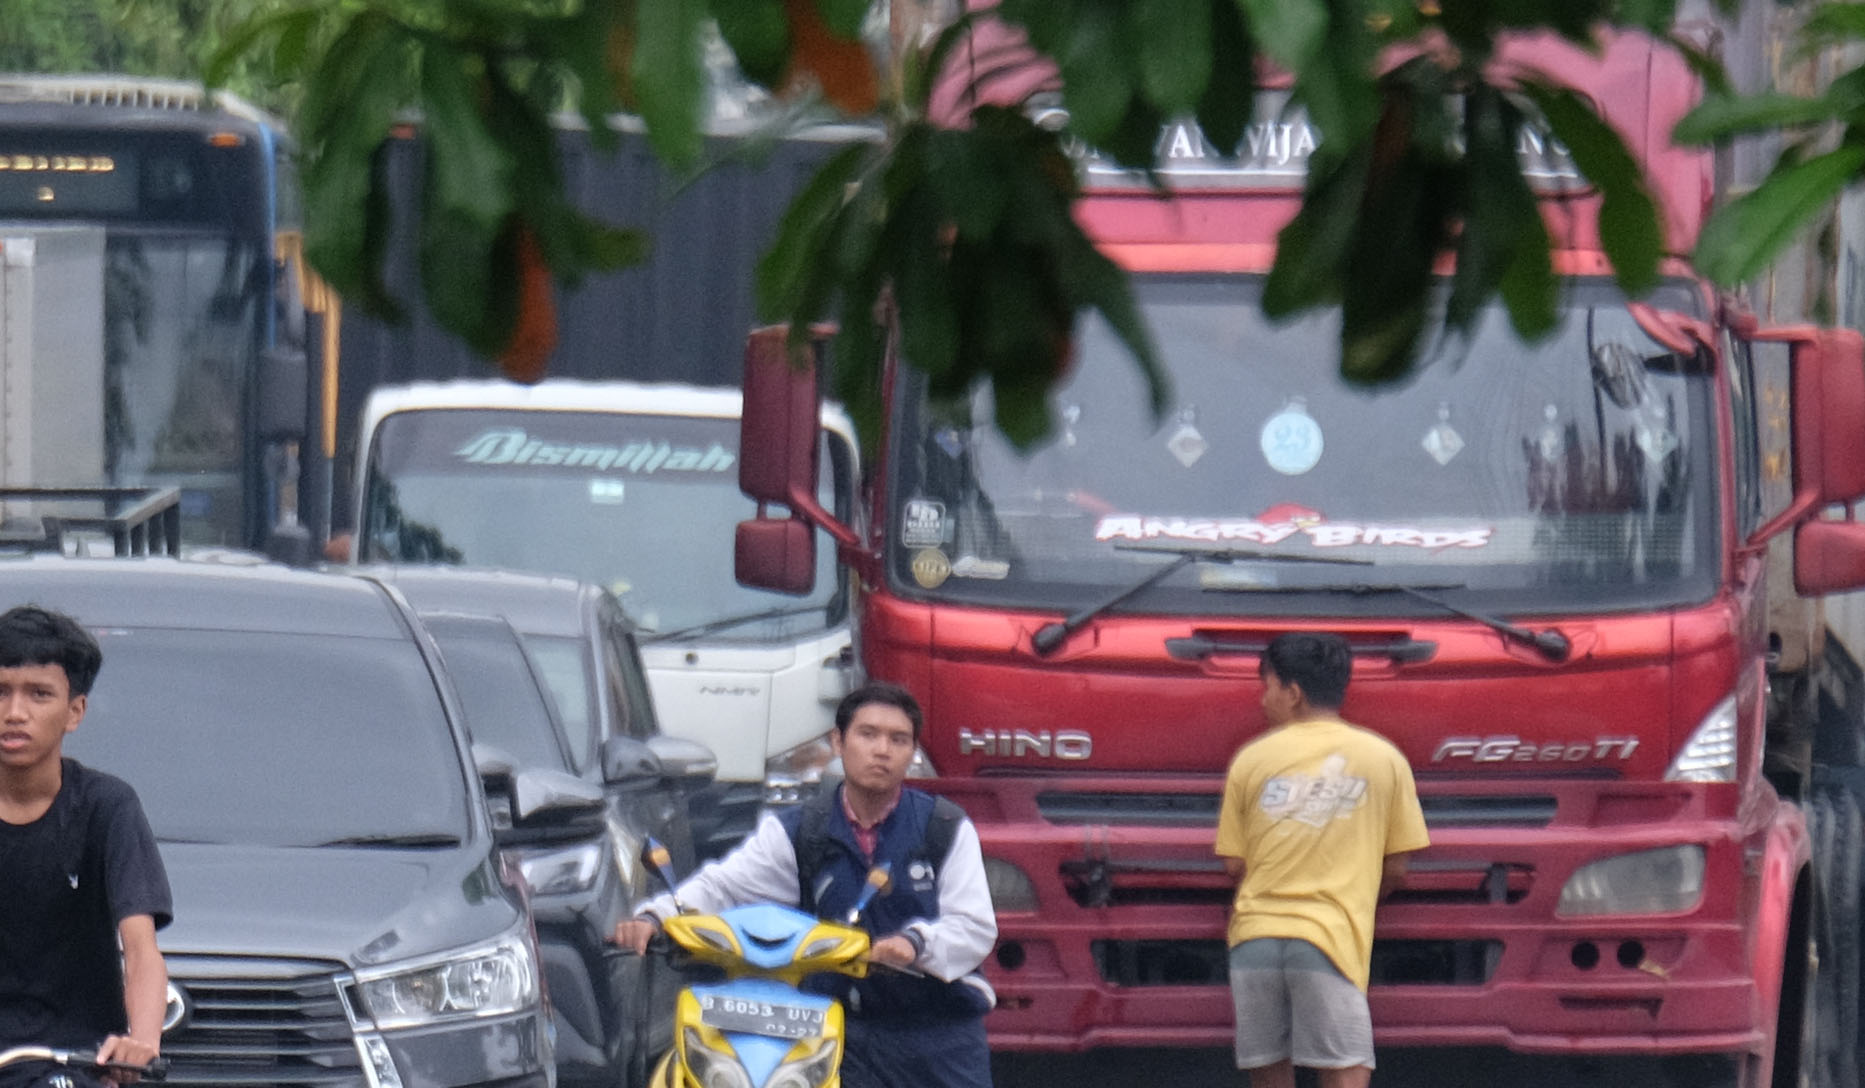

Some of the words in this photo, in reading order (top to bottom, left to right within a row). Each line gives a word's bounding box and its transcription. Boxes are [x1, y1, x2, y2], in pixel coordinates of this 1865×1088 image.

[455, 431, 735, 473] Bismillah
[1095, 514, 1302, 544] ANGRY
[1306, 525, 1494, 548] BIRDS
[959, 729, 1092, 761] HINO
